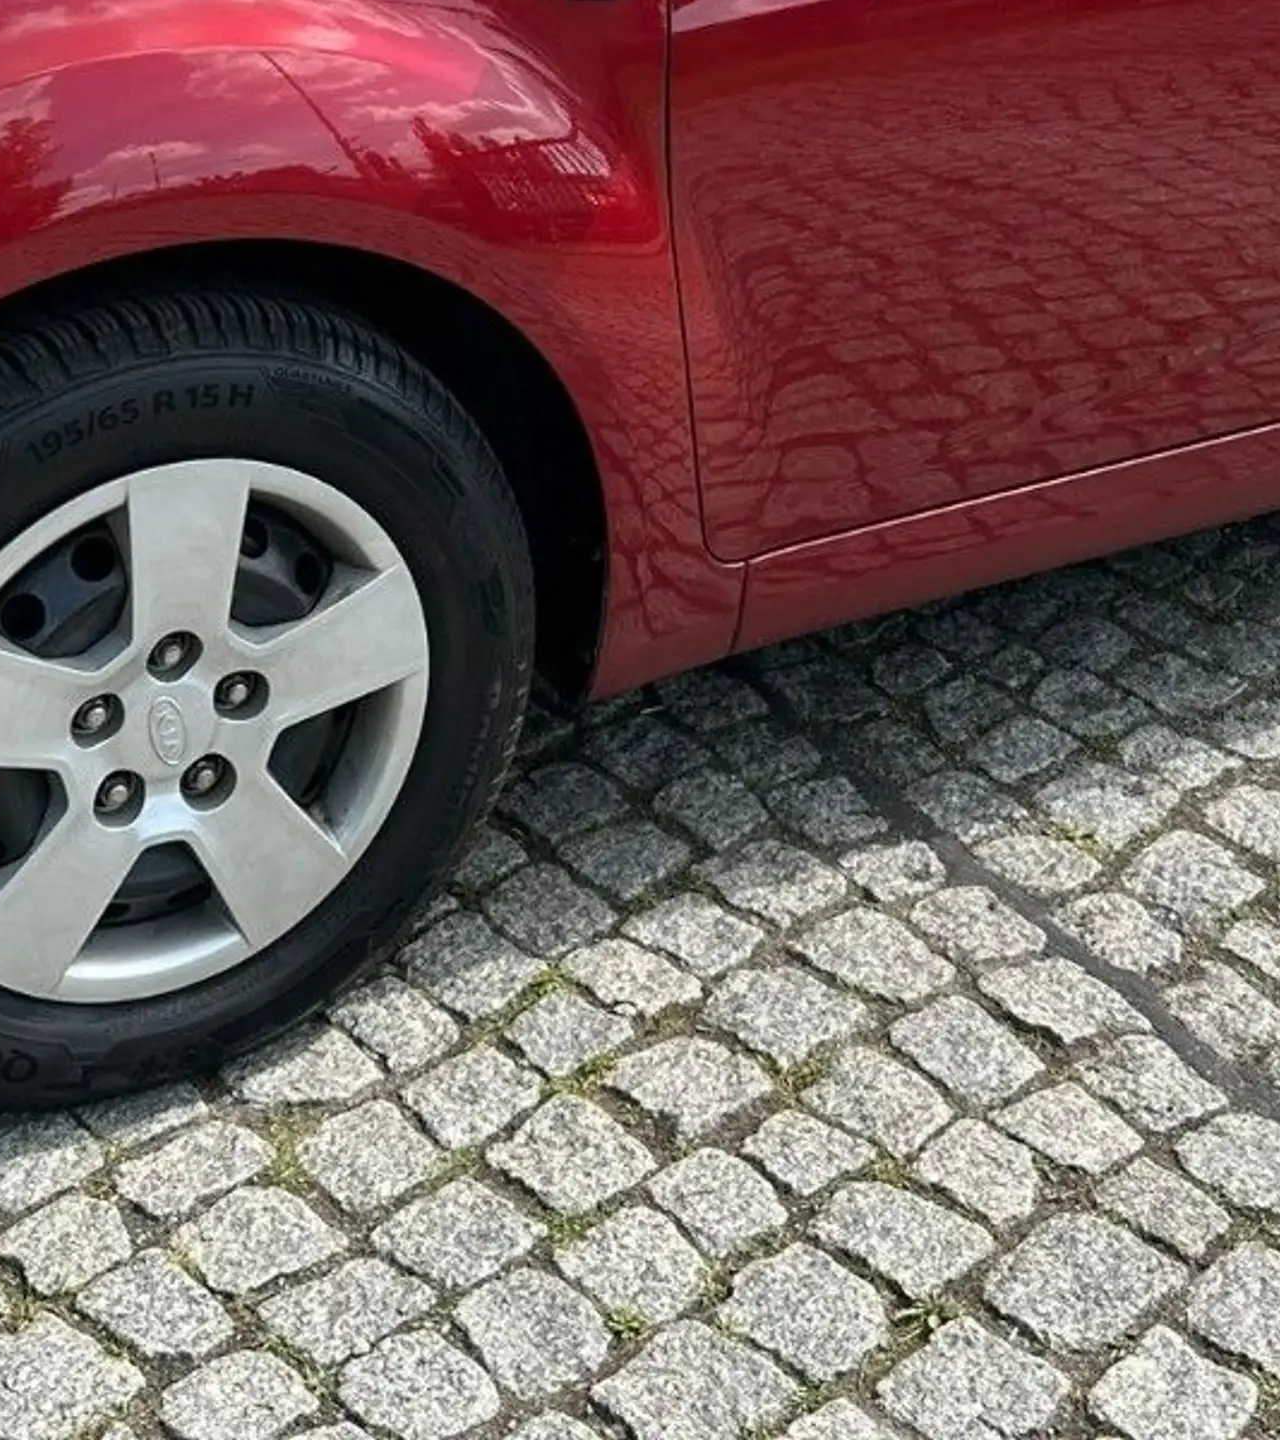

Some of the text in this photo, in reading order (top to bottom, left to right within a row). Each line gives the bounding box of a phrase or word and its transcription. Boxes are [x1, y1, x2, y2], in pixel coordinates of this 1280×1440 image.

[24, 382, 257, 465] 195/65 R 15 H
